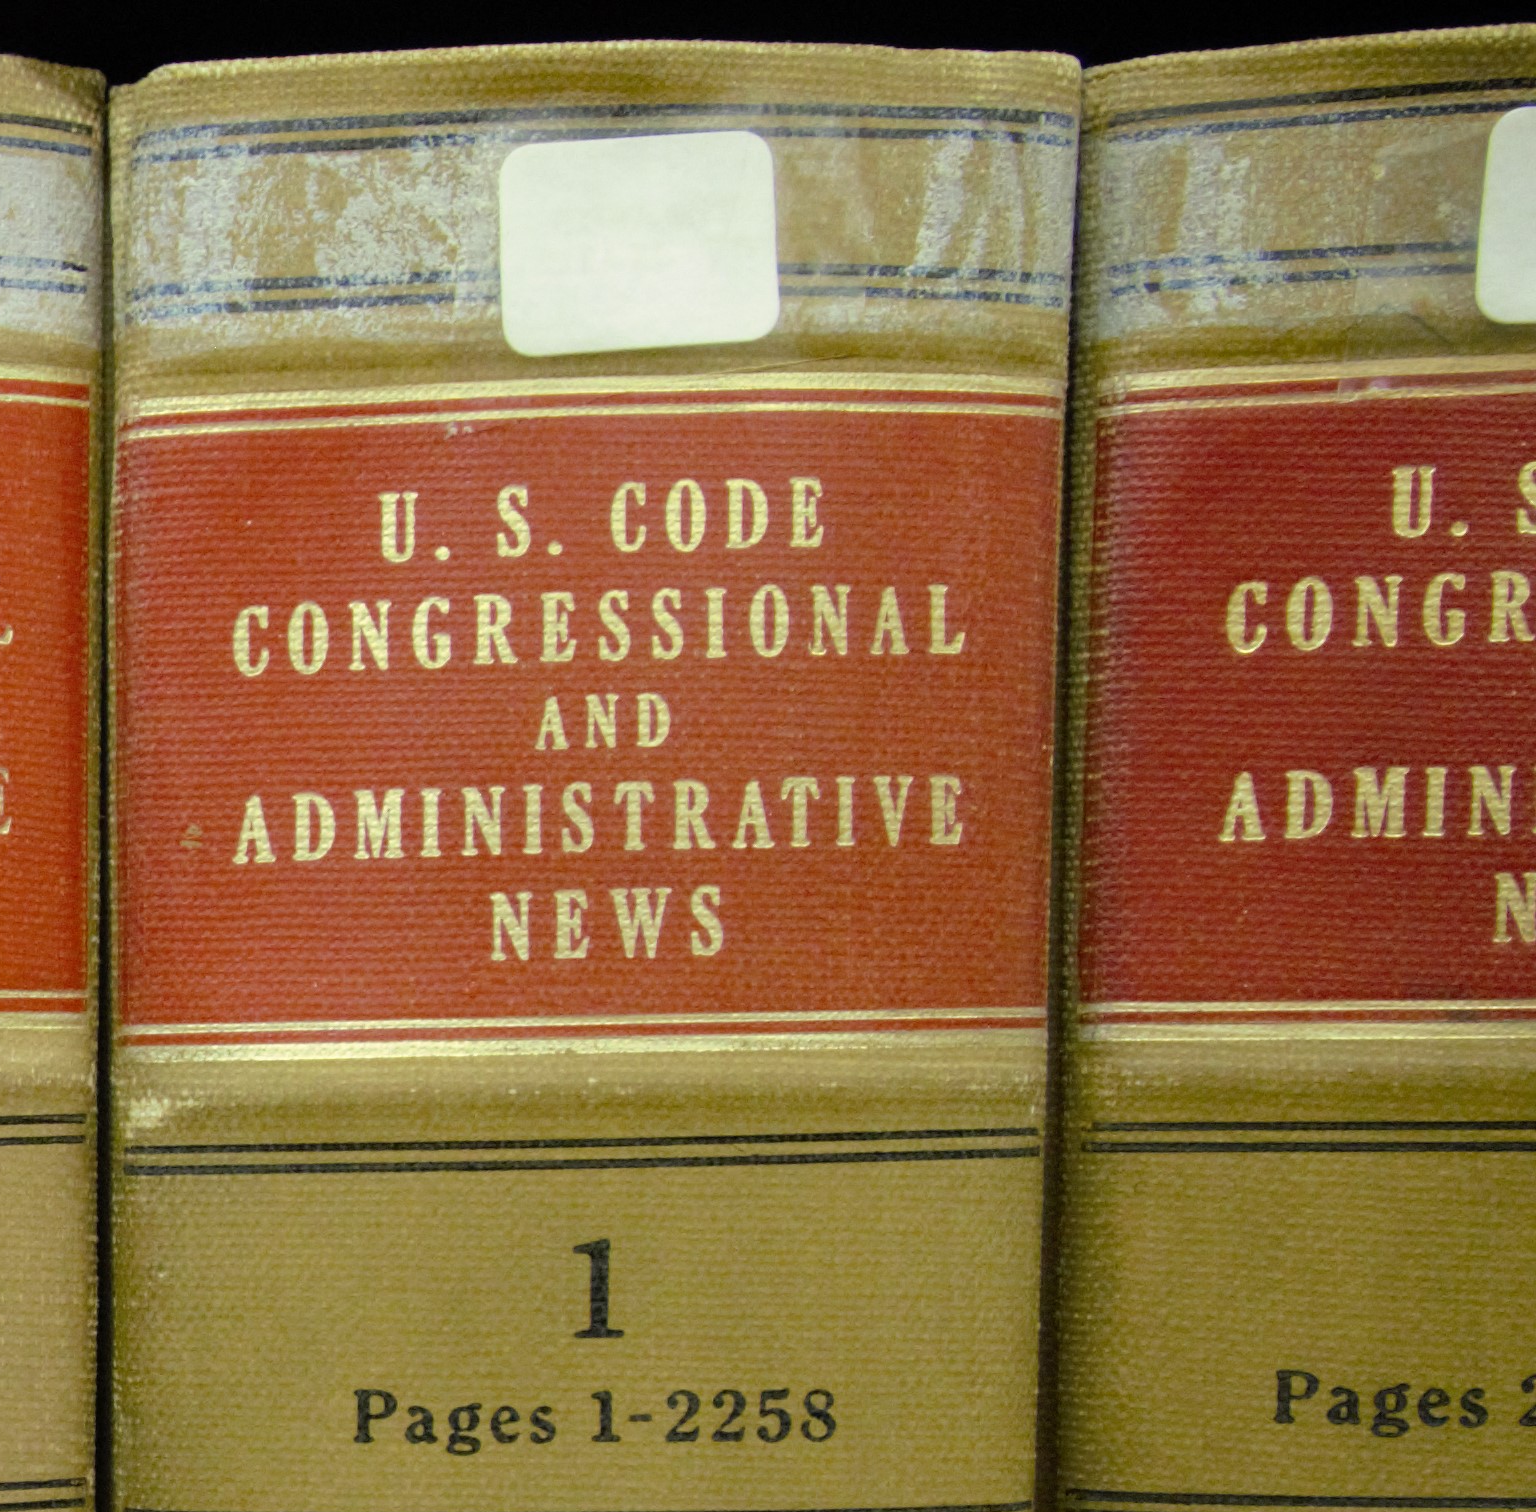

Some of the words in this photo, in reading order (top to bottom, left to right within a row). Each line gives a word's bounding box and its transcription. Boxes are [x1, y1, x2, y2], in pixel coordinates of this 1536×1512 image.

[379, 491, 451, 564] U.
[497, 484, 564, 559] S.
[609, 476, 825, 554] CODE
[1392, 465, 1469, 539] U.
[232, 583, 965, 678] CONGRESSIONAL
[1226, 570, 1536, 654] CONGR
[535, 692, 672, 751] AND
[231, 774, 965, 865] ADMINISTRATIVE
[1219, 765, 1536, 842] ADMIN
[489, 884, 725, 962] NEWS
[573, 1238, 625, 1340] 1
[353, 1388, 556, 1457] Pages
[590, 1387, 838, 1444] 1-2258
[1273, 1369, 1489, 1438] Pages
